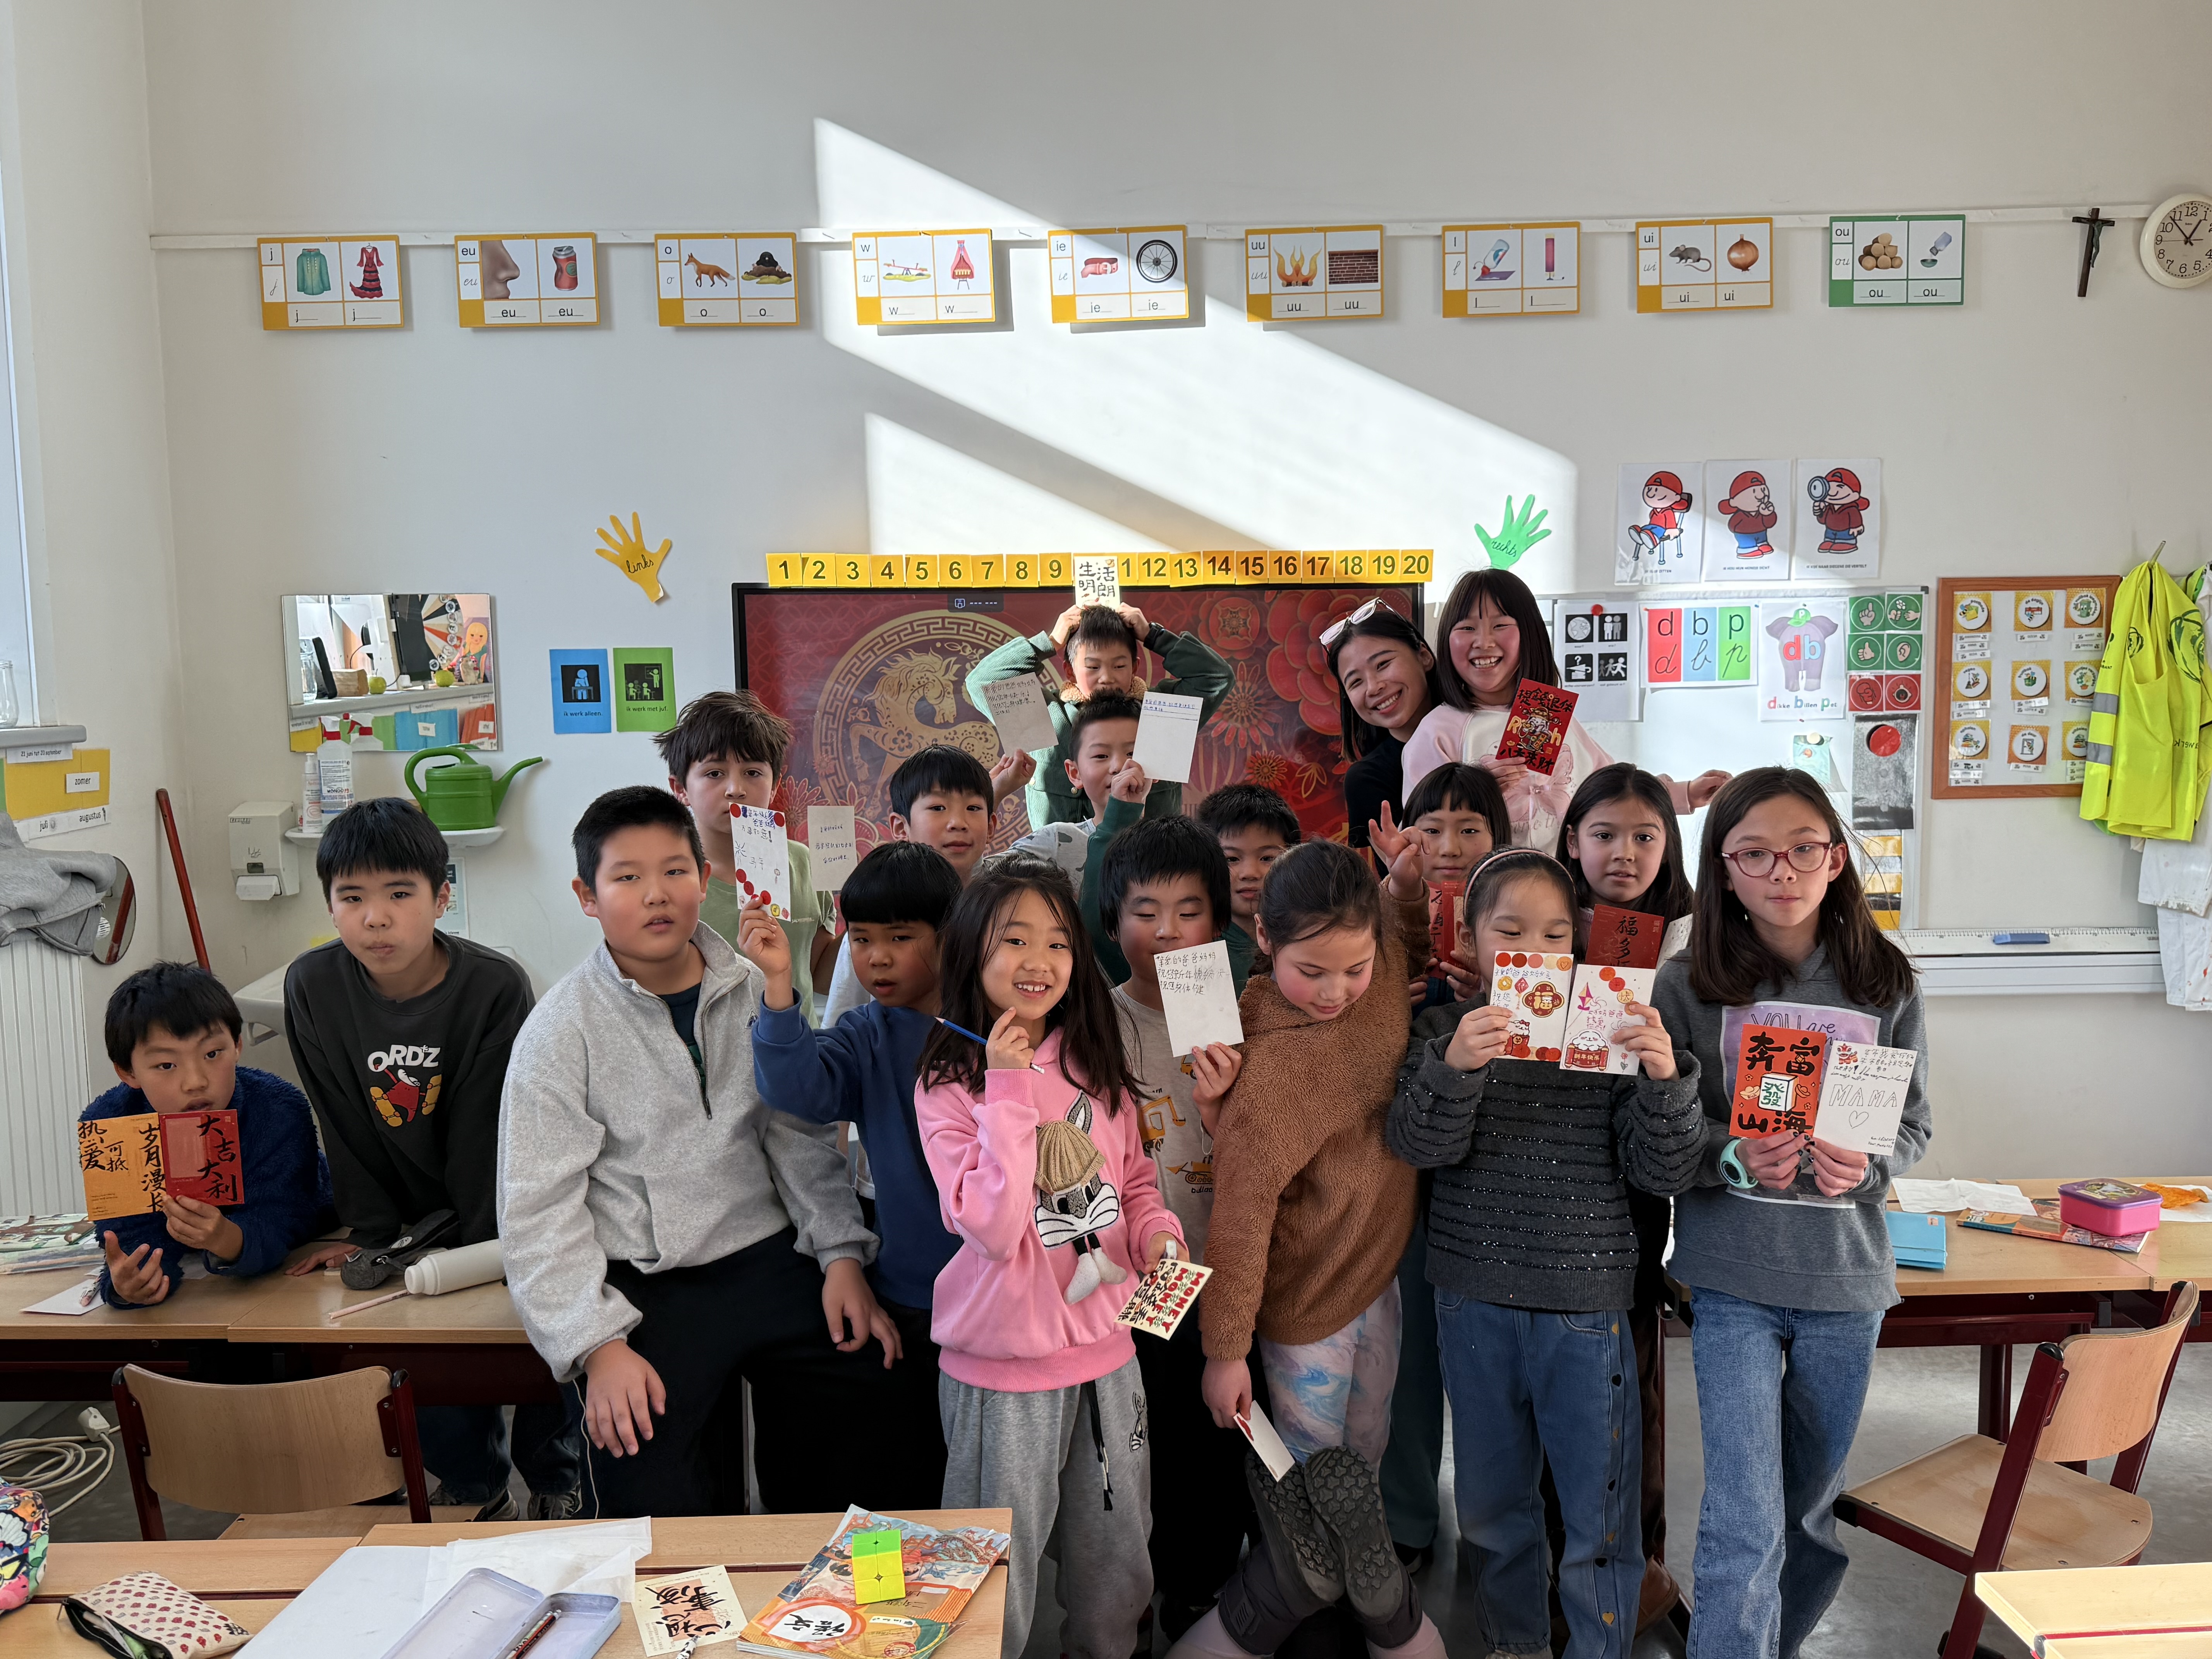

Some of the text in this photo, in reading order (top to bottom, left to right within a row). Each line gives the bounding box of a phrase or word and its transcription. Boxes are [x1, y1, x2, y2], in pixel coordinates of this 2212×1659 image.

[2173, 211, 2182, 221] 11
[2184, 206, 2198, 216] 12
[2202, 211, 2207, 220] 1
[2160, 222, 2173, 232] 10
[1454, 237, 1456, 247] l
[1644, 232, 1654, 243] ui
[2156, 235, 2162, 245] 9
[665, 246, 672, 254] o
[1056, 243, 1066, 251] ie
[1252, 242, 1265, 250] uu
[270, 248, 273, 261] j
[2158, 249, 2165, 259] 8
[2167, 259, 2174, 269] 7
[2179, 263, 2187, 273] 6
[2193, 261, 2201, 270] 5
[1680, 290, 1734, 303] ui ui
[1869, 289, 1937, 298] ou ou
[1091, 299, 1158, 313] ie ie
[1287, 301, 1359, 312] uu uu
[1475, 295, 1533, 309] l l
[296, 309, 356, 323] j j
[501, 308, 573, 318] eu eu
[700, 309, 708, 317] o
[889, 306, 954, 316] w w
[1491, 539, 1517, 558] rechts
[627, 555, 654, 574] links
[779, 560, 789, 579] 1
[812, 560, 826, 579] 2
[847, 561, 859, 580] 3
[881, 562, 894, 580] 4
[916, 562, 928, 580] 5
[949, 561, 962, 579] 6
[981, 561, 994, 580] 7
[1016, 561, 1028, 580] 8
[1049, 560, 1061, 578] 9
[1142, 558, 1166, 577] 12
[1174, 558, 1197, 578] 13
[1207, 556, 1231, 575] 14
[1240, 556, 1264, 576] 15
[1274, 556, 1297, 575] 16
[1307, 556, 1329, 575] 17
[1340, 556, 1363, 575] 18
[1372, 555, 1395, 575] 19
[1403, 555, 1429, 574] 20
[1079, 562, 1115, 581] 生活
[1079, 579, 1115, 597] 明朗
[1658, 611, 1744, 639] d b p
[1783, 634, 1821, 660] d b
[1655, 639, 1747, 678] d b p
[1767, 696, 1837, 711] dikke billen pet
[79, 811, 101, 823] augustus
[40, 820, 48, 831] juli
[368, 1044, 440, 1072] ORDZ
[197, 1115, 238, 1202] 大吉大利
[1146, 1267, 1189, 1327] MONEY
[1162, 1272, 1205, 1334] MONEY
[784, 1614, 845, 1637] 语文
